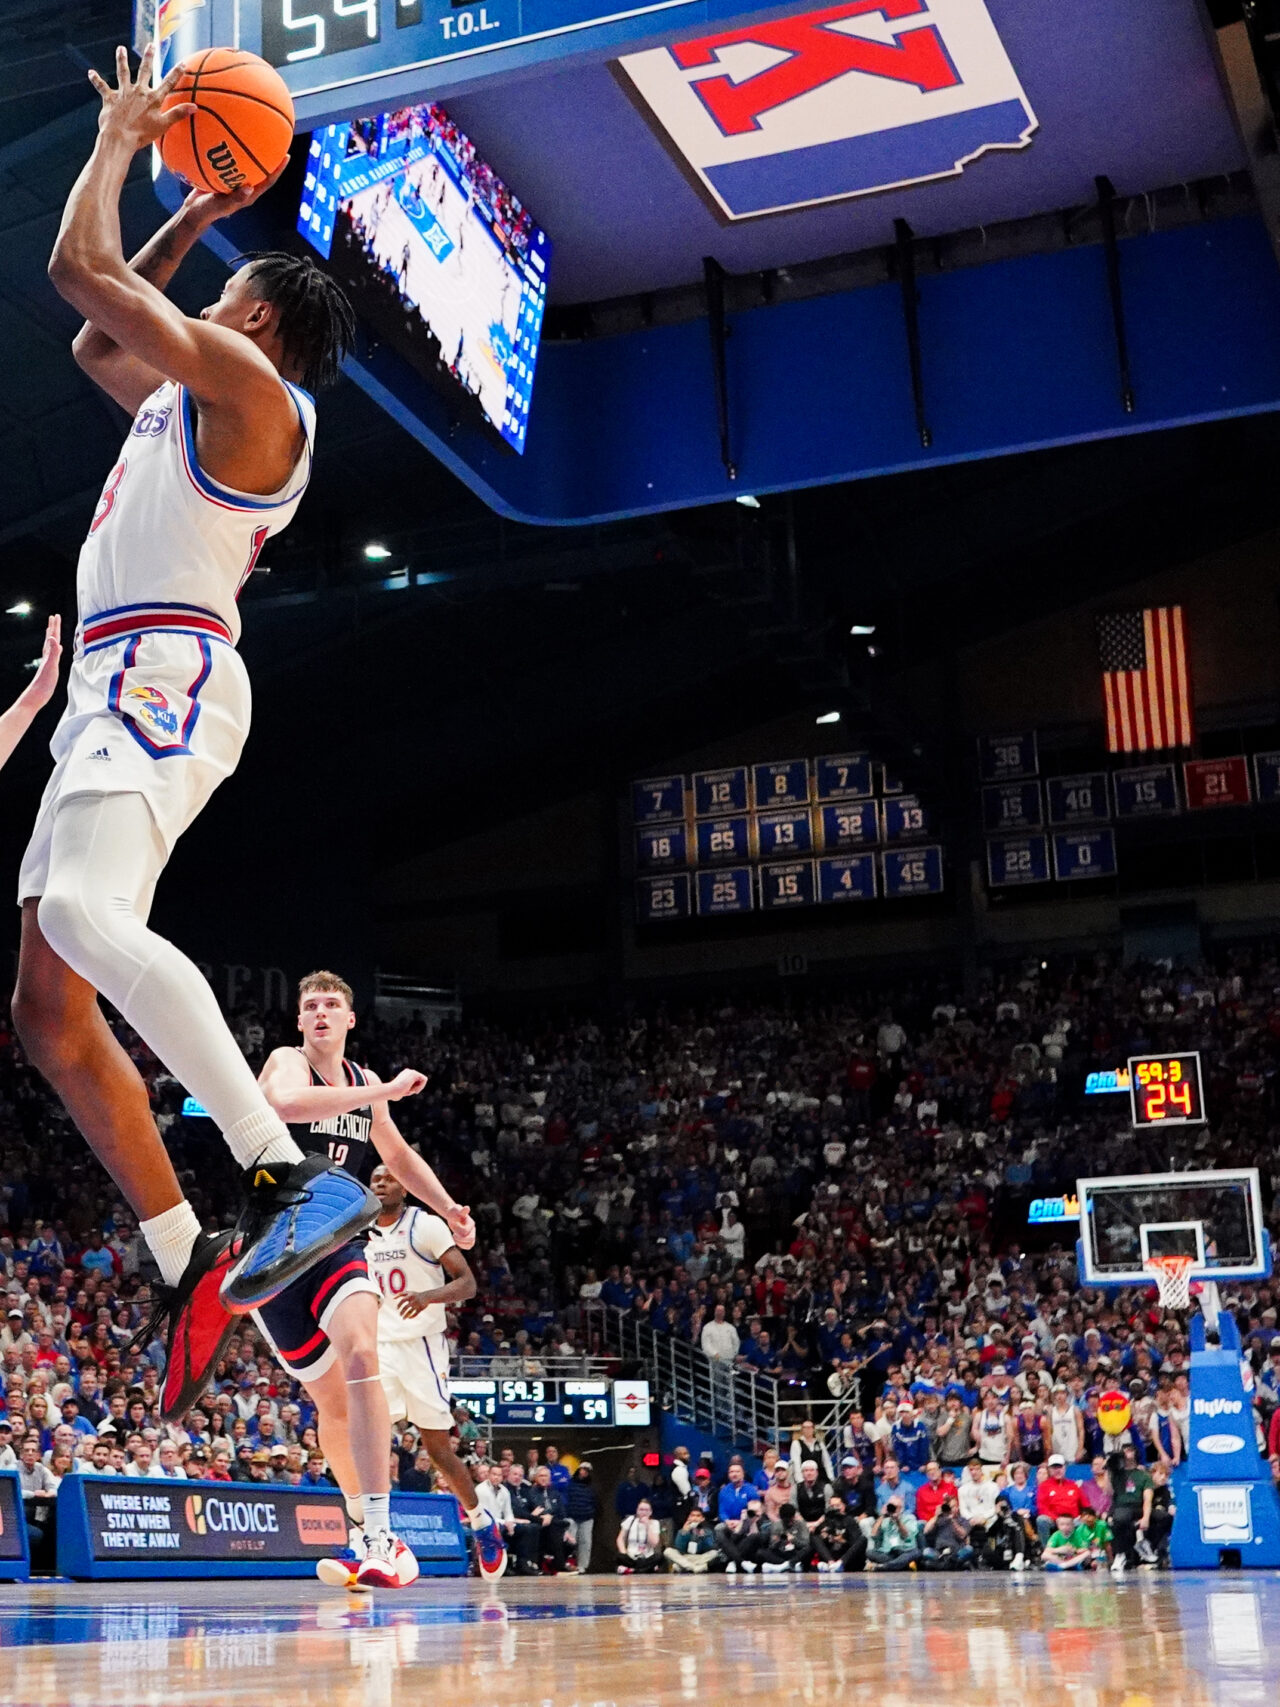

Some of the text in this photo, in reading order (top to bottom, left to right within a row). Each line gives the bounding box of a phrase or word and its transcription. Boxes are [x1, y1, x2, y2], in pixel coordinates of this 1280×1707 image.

[440, 8, 501, 40] T.O.L.
[206, 140, 246, 192] Wils
[157, 709, 171, 724] KU
[1205, 772, 1229, 795] 21
[837, 814, 863, 837] 32
[902, 808, 924, 829] 13
[710, 830, 734, 852] 25
[774, 823, 794, 844] 13
[900, 861, 925, 883] 45
[1005, 850, 1032, 872] 22
[777, 874, 798, 896] 15
[1136, 1060, 1182, 1085] 59.3
[1146, 1082, 1192, 1118] 24
[309, 1112, 372, 1144] CONNECTICUT
[502, 1381, 545, 1402] 59.3
[583, 1399, 608, 1420] 59
[100, 1493, 172, 1512] WHERE FANS
[106, 1512, 172, 1530] STAY WHEN
[205, 1497, 280, 1533] CHOICE
[301, 1518, 323, 1531] BOOK
[100, 1531, 180, 1548] THEY'RE AWAY
